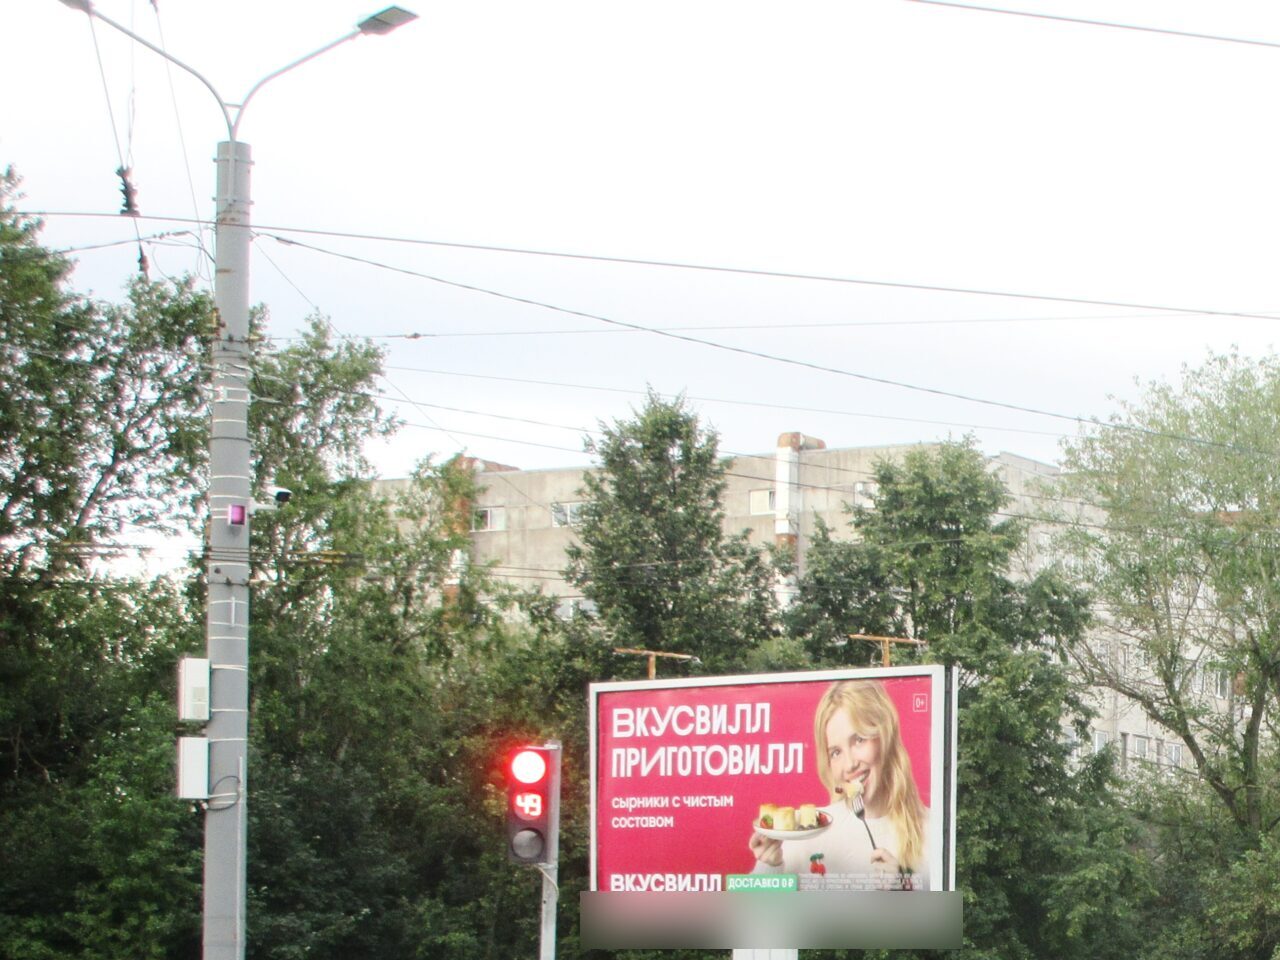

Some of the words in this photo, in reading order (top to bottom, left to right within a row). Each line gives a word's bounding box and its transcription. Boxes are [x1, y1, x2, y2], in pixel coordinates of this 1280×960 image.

[612, 702, 771, 738] ВКУСВИЛЛ
[611, 742, 804, 778] ПРИГОТОВИЛЛ
[516, 793, 542, 816] 49
[611, 795, 669, 812] сырники
[671, 796, 681, 808] с
[682, 795, 734, 808] чистым
[611, 816, 674, 829] составом
[610, 873, 722, 892] ВКУСВИЛЛ
